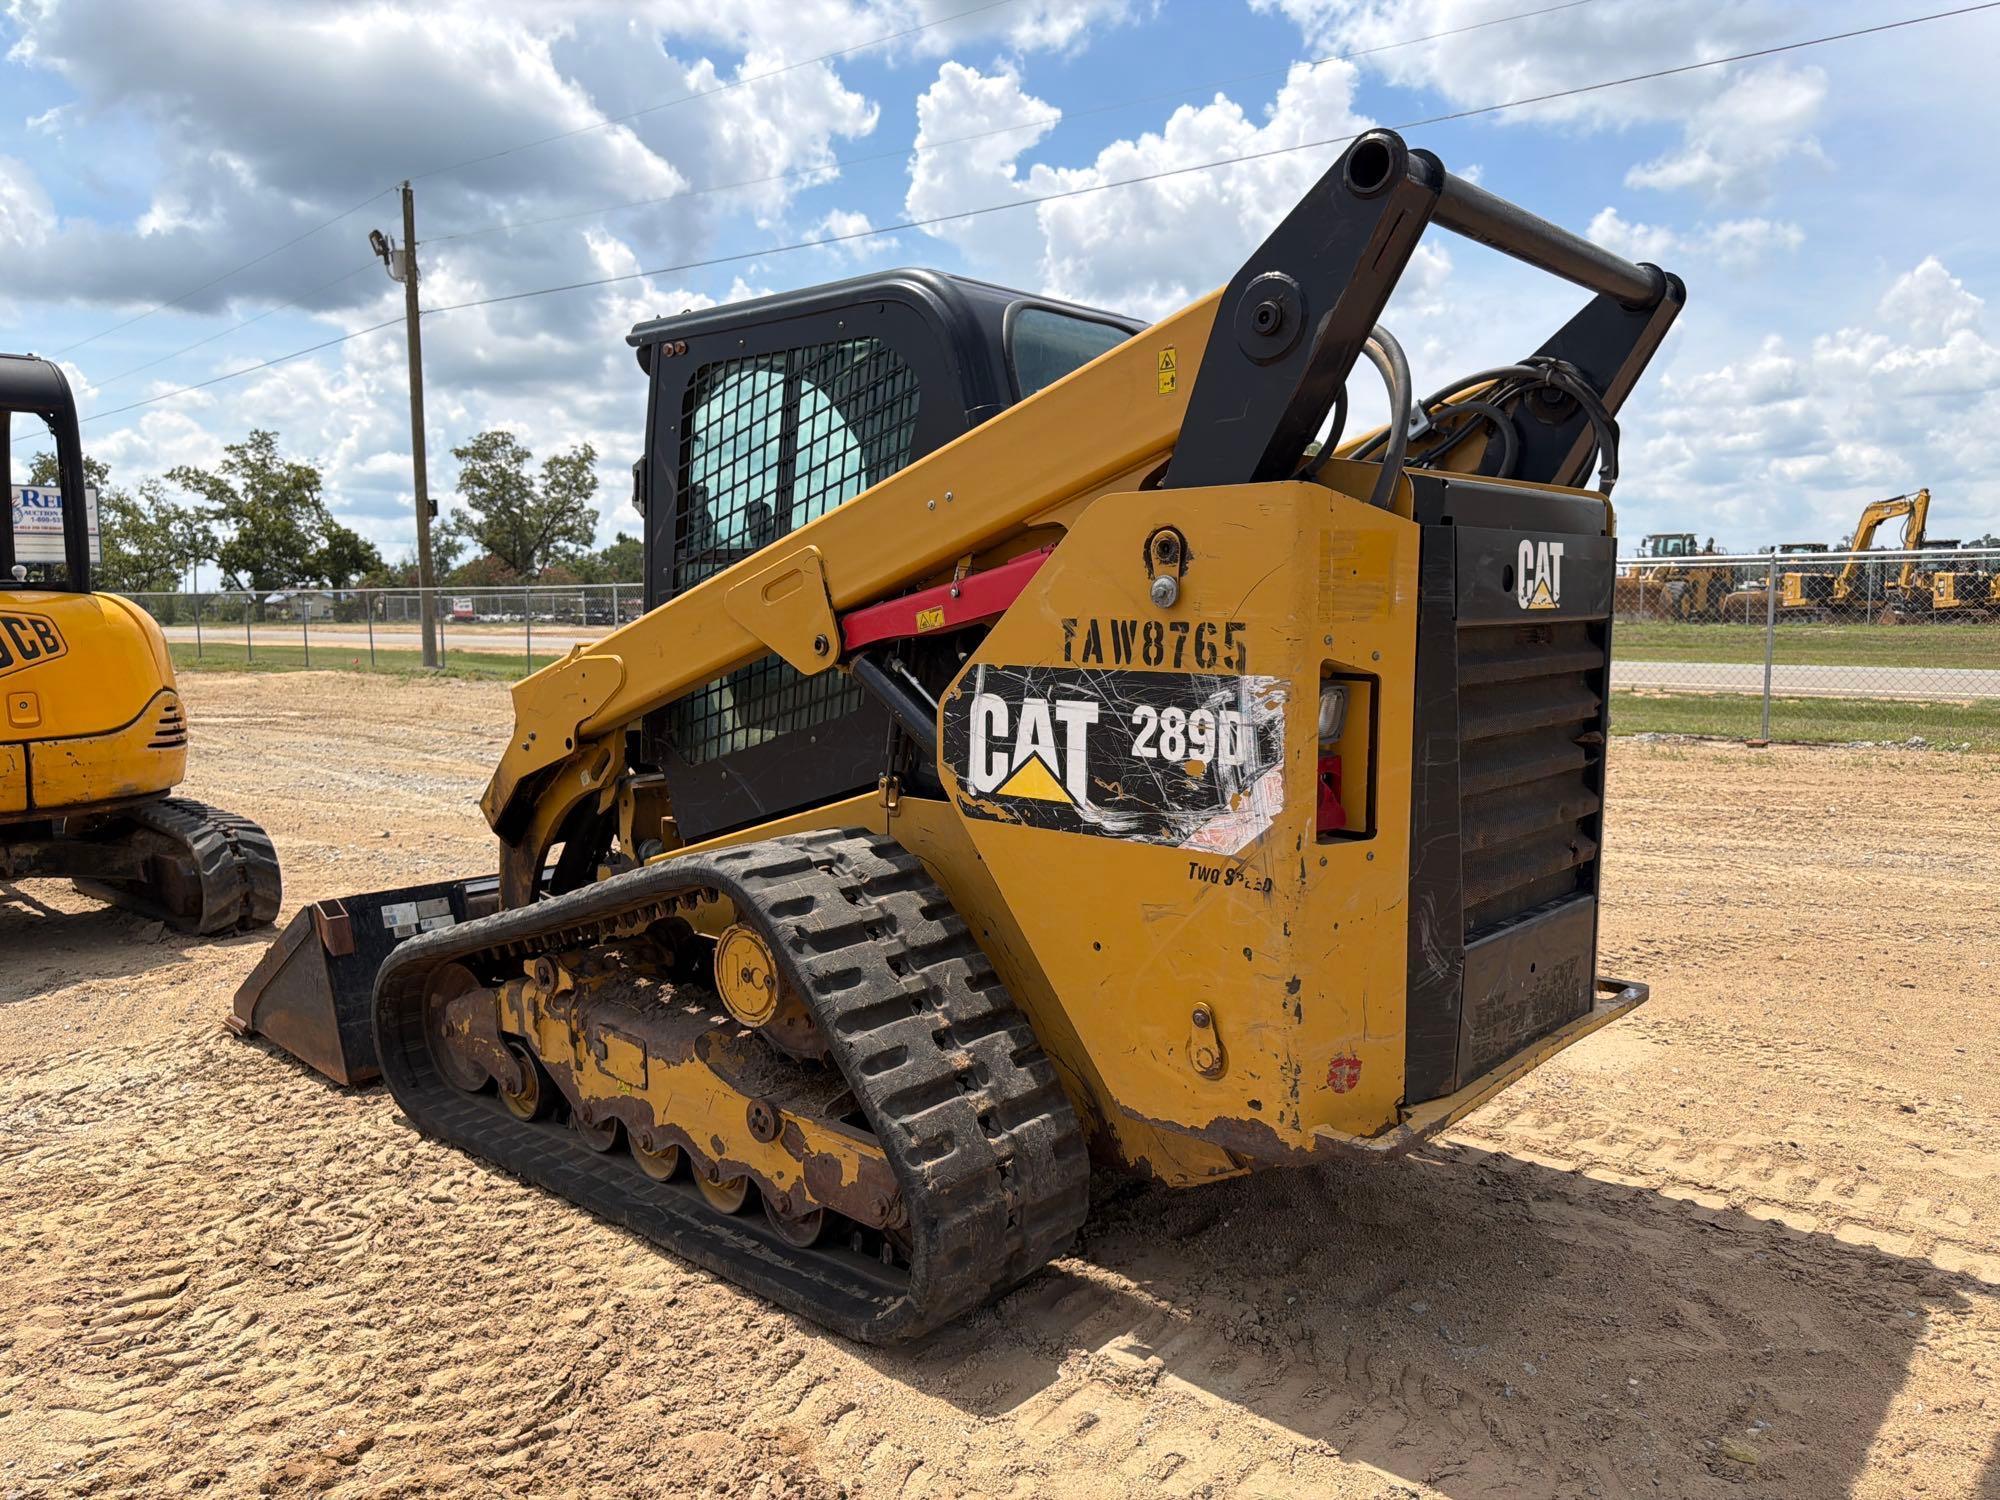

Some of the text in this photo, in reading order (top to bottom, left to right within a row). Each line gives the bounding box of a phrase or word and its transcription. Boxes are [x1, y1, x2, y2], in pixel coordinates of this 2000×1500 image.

[1518, 539, 1564, 609] CAT
[969, 693, 1248, 810] CAT 289D
[1189, 861, 1221, 884] TWO
